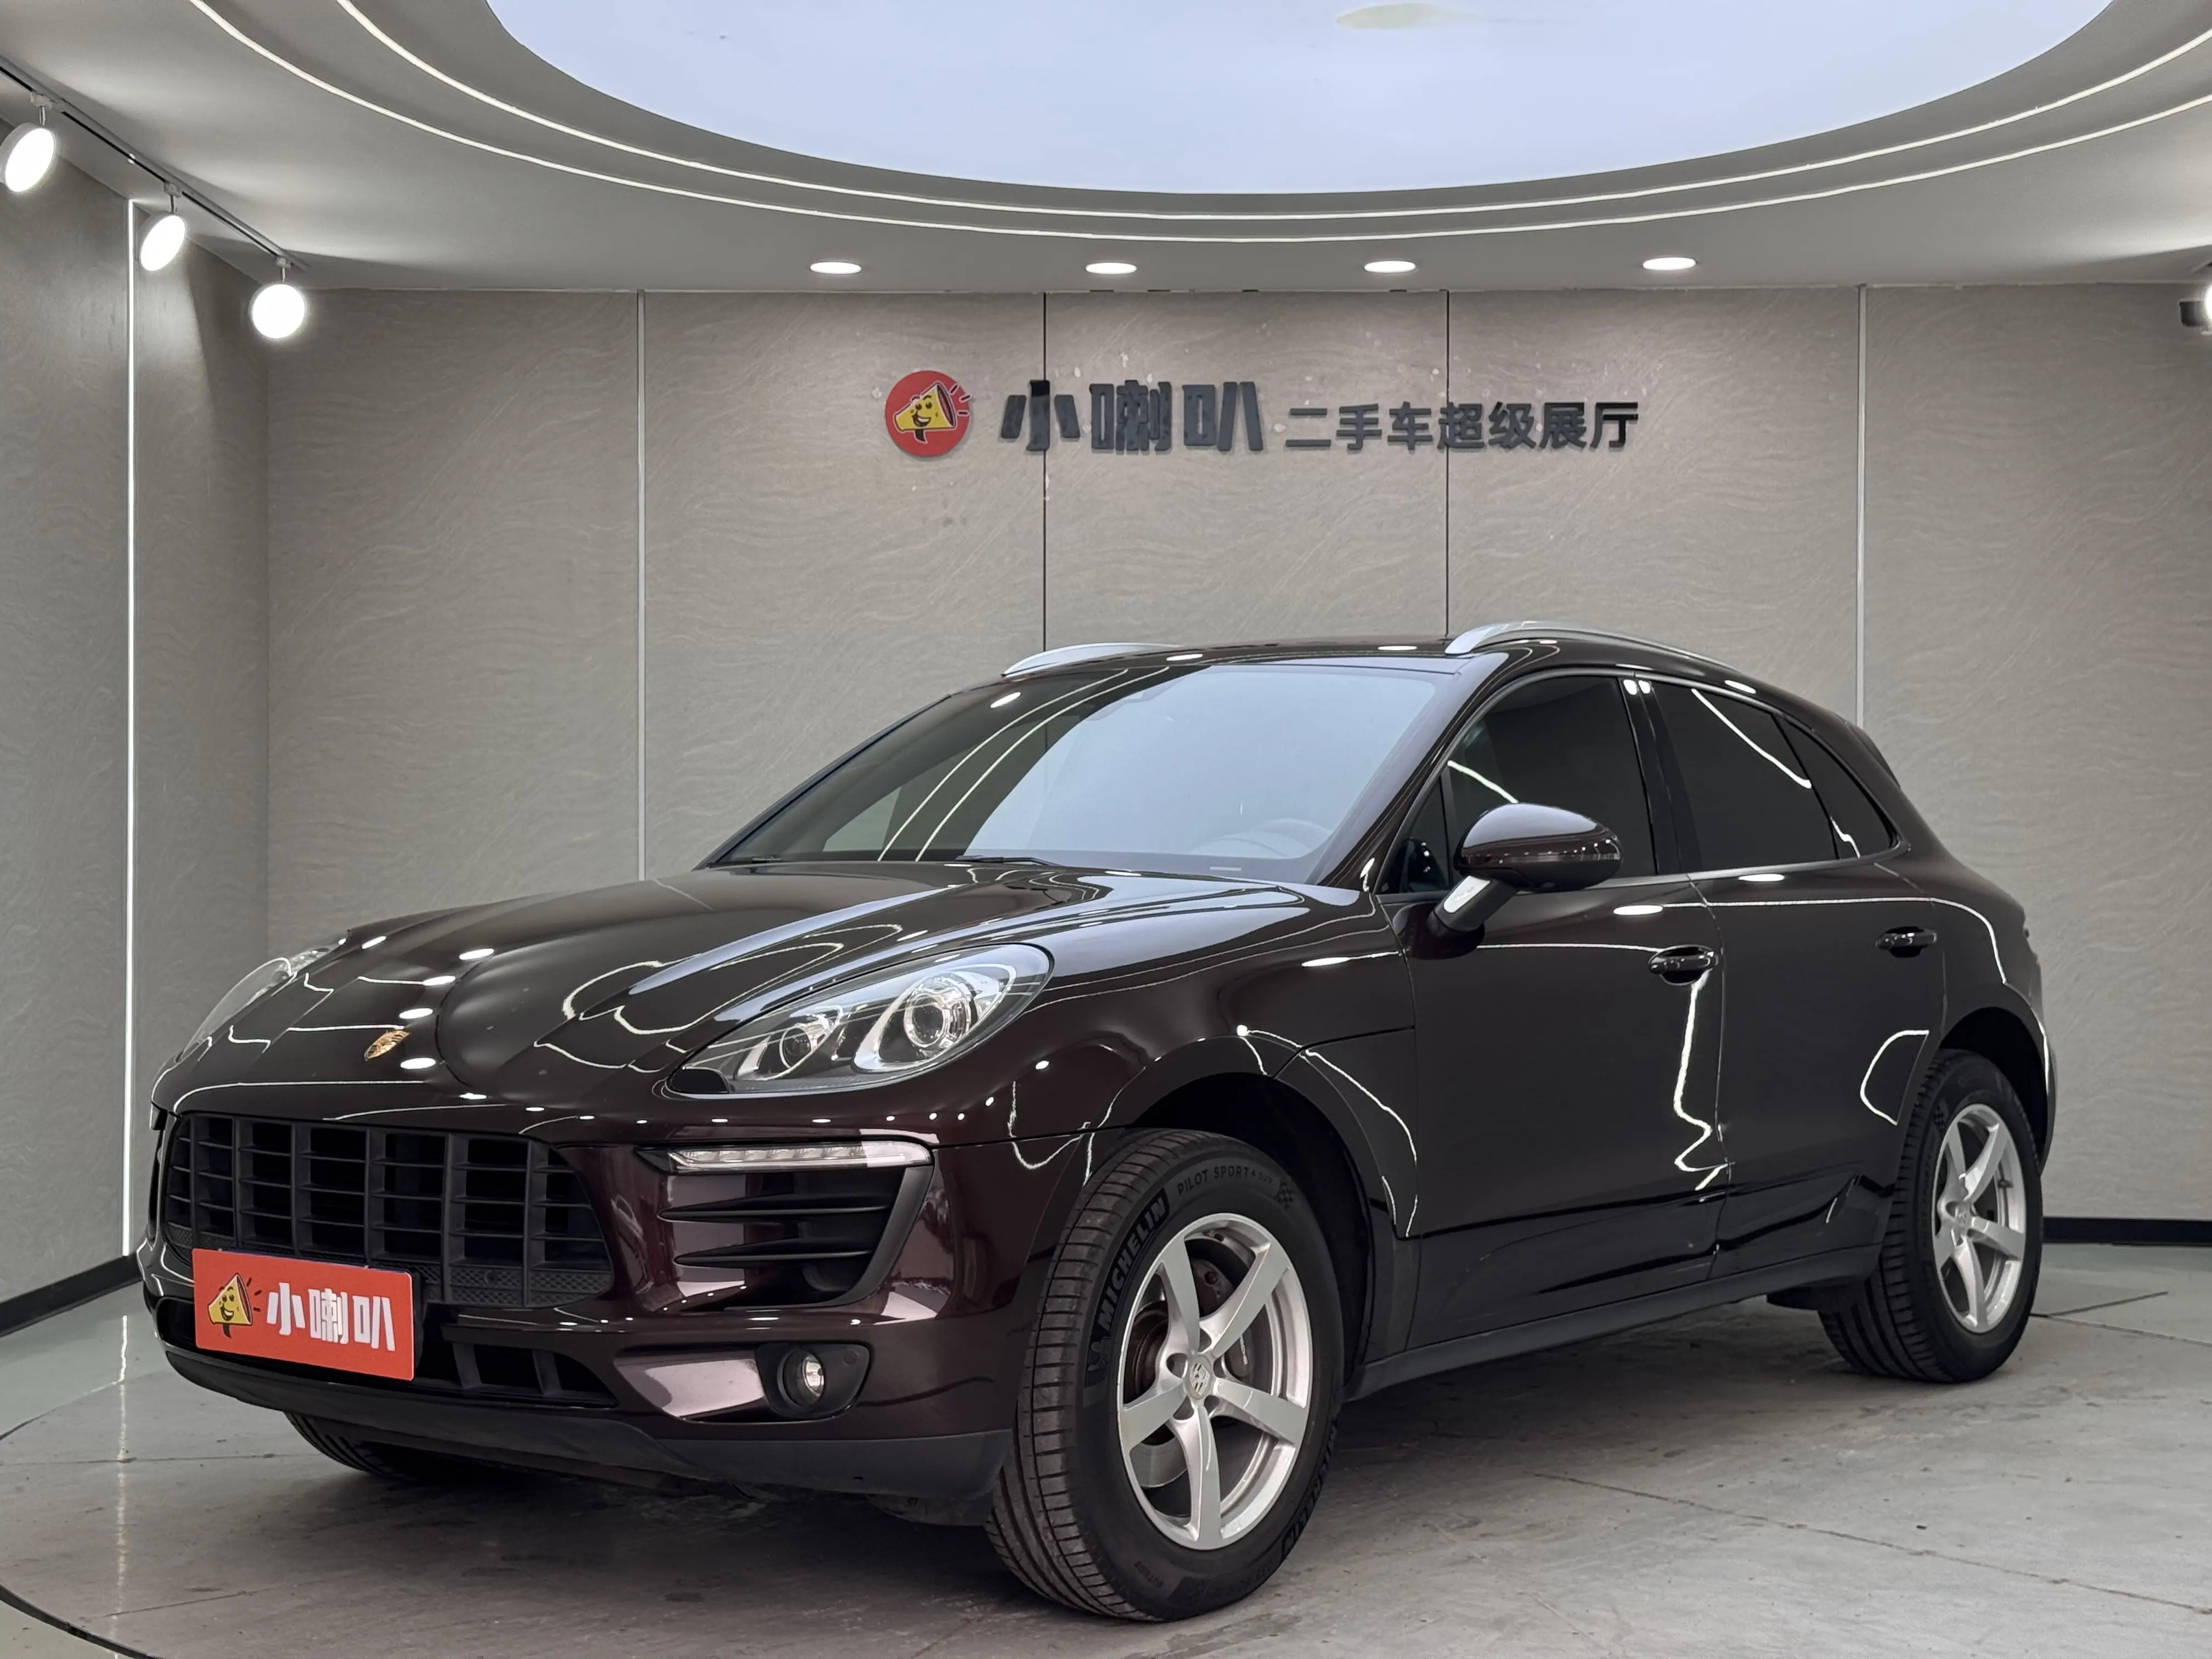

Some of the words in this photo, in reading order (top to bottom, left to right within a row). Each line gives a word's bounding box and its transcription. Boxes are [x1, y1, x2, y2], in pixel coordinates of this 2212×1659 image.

[1001, 380, 1263, 451] 小喇叭
[1285, 401, 1639, 450] 二手车超级展厅
[1177, 1169, 1208, 1197] PILOT
[1214, 1165, 1249, 1180] SPORT
[1098, 1197, 1166, 1331] MICHELIN
[266, 1282, 396, 1352] 小喇叭
